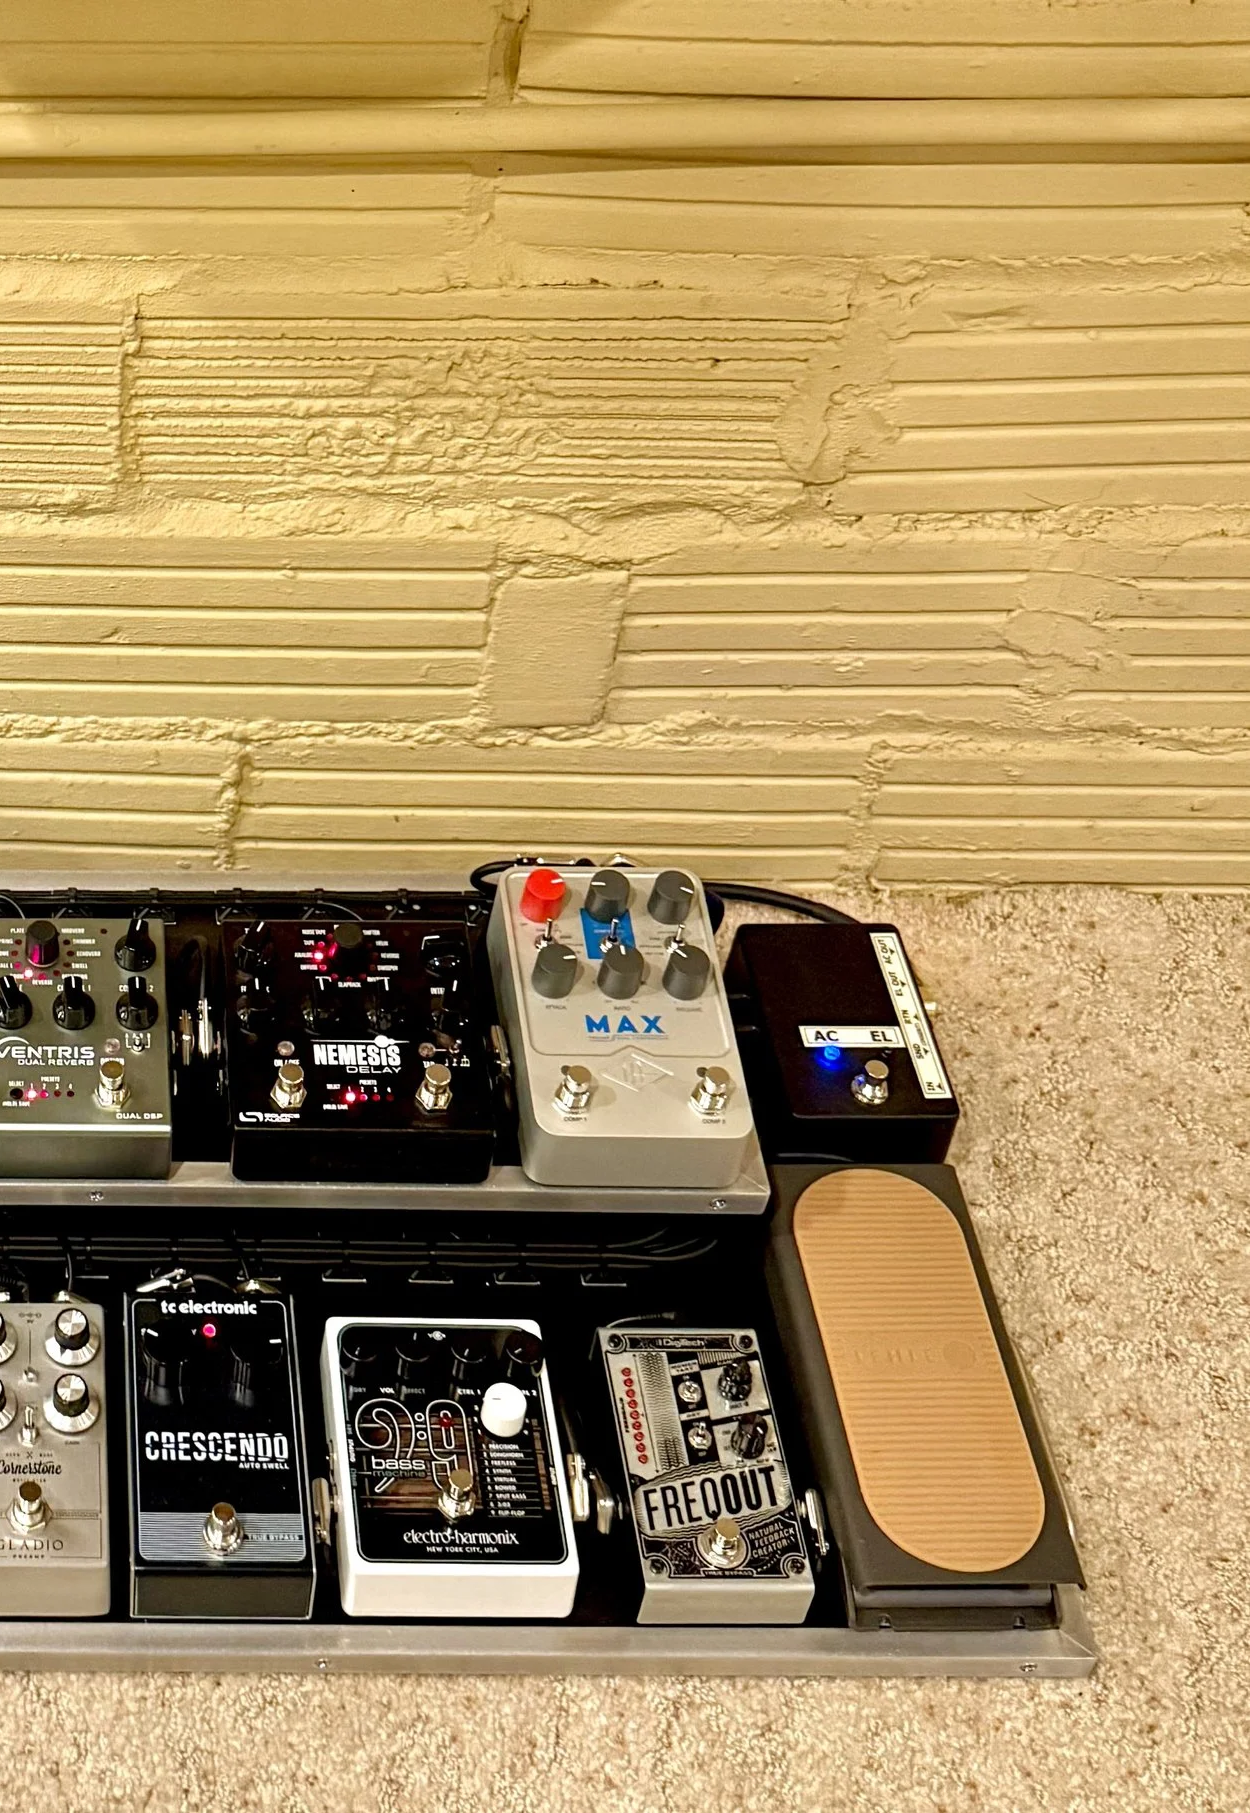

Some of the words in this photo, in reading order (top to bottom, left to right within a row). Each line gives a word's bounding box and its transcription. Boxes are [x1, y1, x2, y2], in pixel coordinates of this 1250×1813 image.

[877, 939, 888, 954] OUT
[882, 954, 892, 964] AC
[888, 971, 899, 986] OUT
[901, 1009, 912, 1024] RTN
[585, 1015, 666, 1034] MAX
[814, 1031, 840, 1042] AC
[871, 1031, 893, 1042] EL
[161, 1301, 177, 1314] tc
[179, 1300, 257, 1315] electronic
[145, 1431, 289, 1462] CRESCENDO
[262, 1462, 290, 1470] SWELL
[372, 1455, 426, 1470] bass
[372, 1469, 427, 1478] machine
[643, 1465, 778, 1531] FREQOUT
[403, 1528, 520, 1544] electro-harmonix
[749, 1521, 784, 1540] NATURAL
[754, 1526, 796, 1548] FEEDBACK
[752, 1539, 788, 1558] CREATOR
